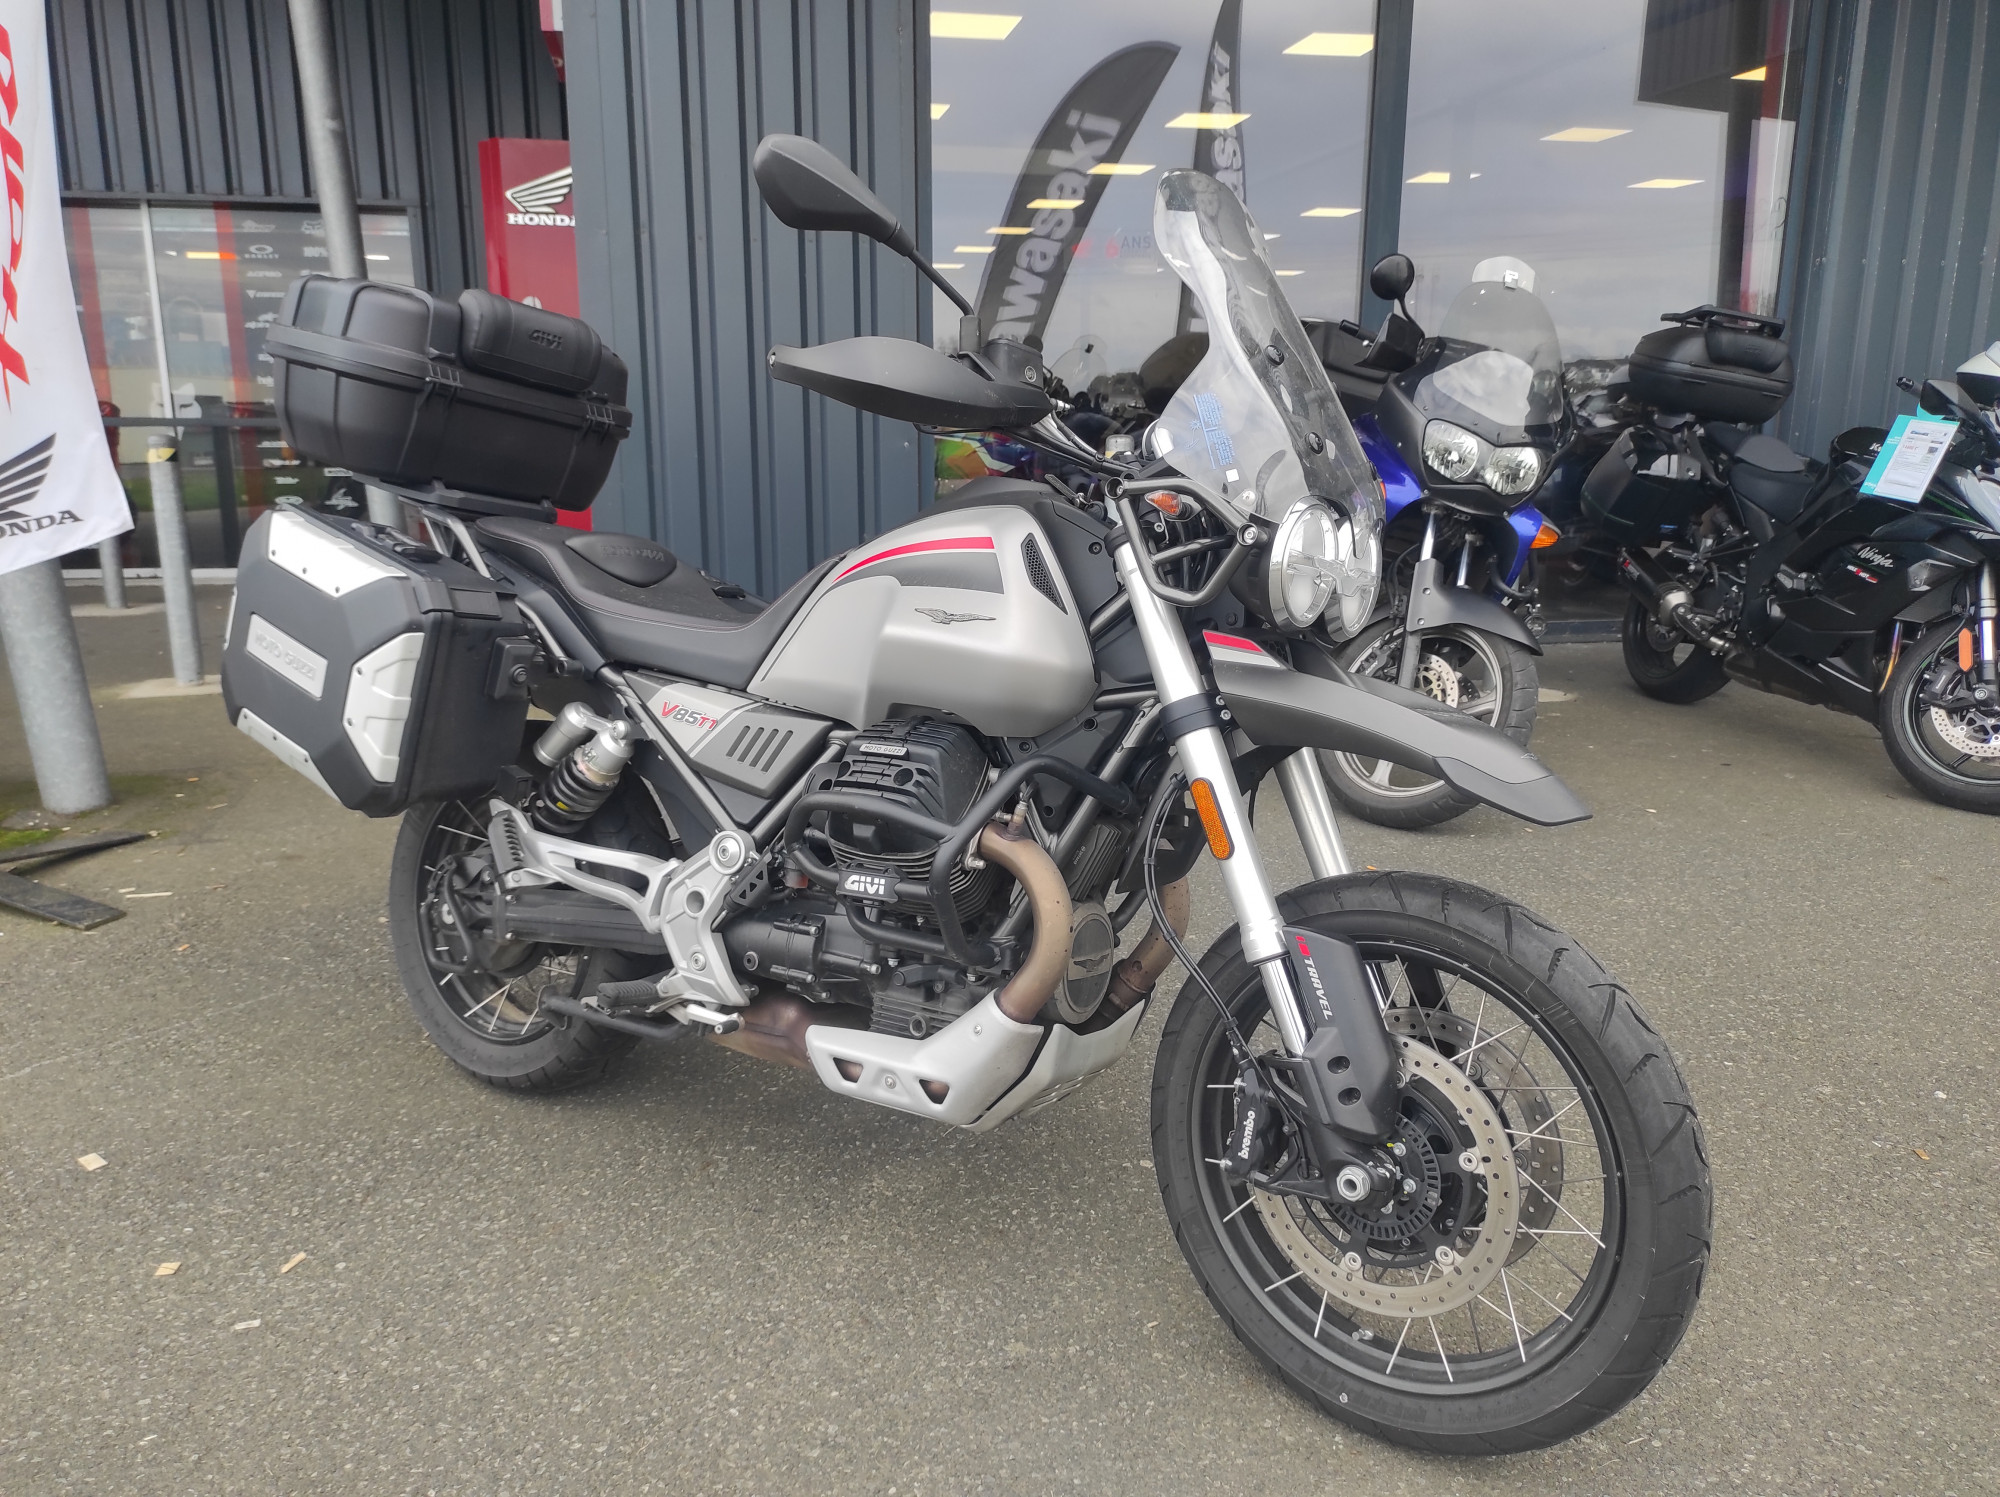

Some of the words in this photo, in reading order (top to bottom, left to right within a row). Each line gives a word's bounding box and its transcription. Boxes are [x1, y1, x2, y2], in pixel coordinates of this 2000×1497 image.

[1121, 235, 1152, 249] ANS
[1857, 546, 1894, 568] Ninja
[844, 875, 886, 895] GIVI
[1304, 957, 1333, 1020] TRAVEL
[1238, 1110, 1256, 1160] brembo
